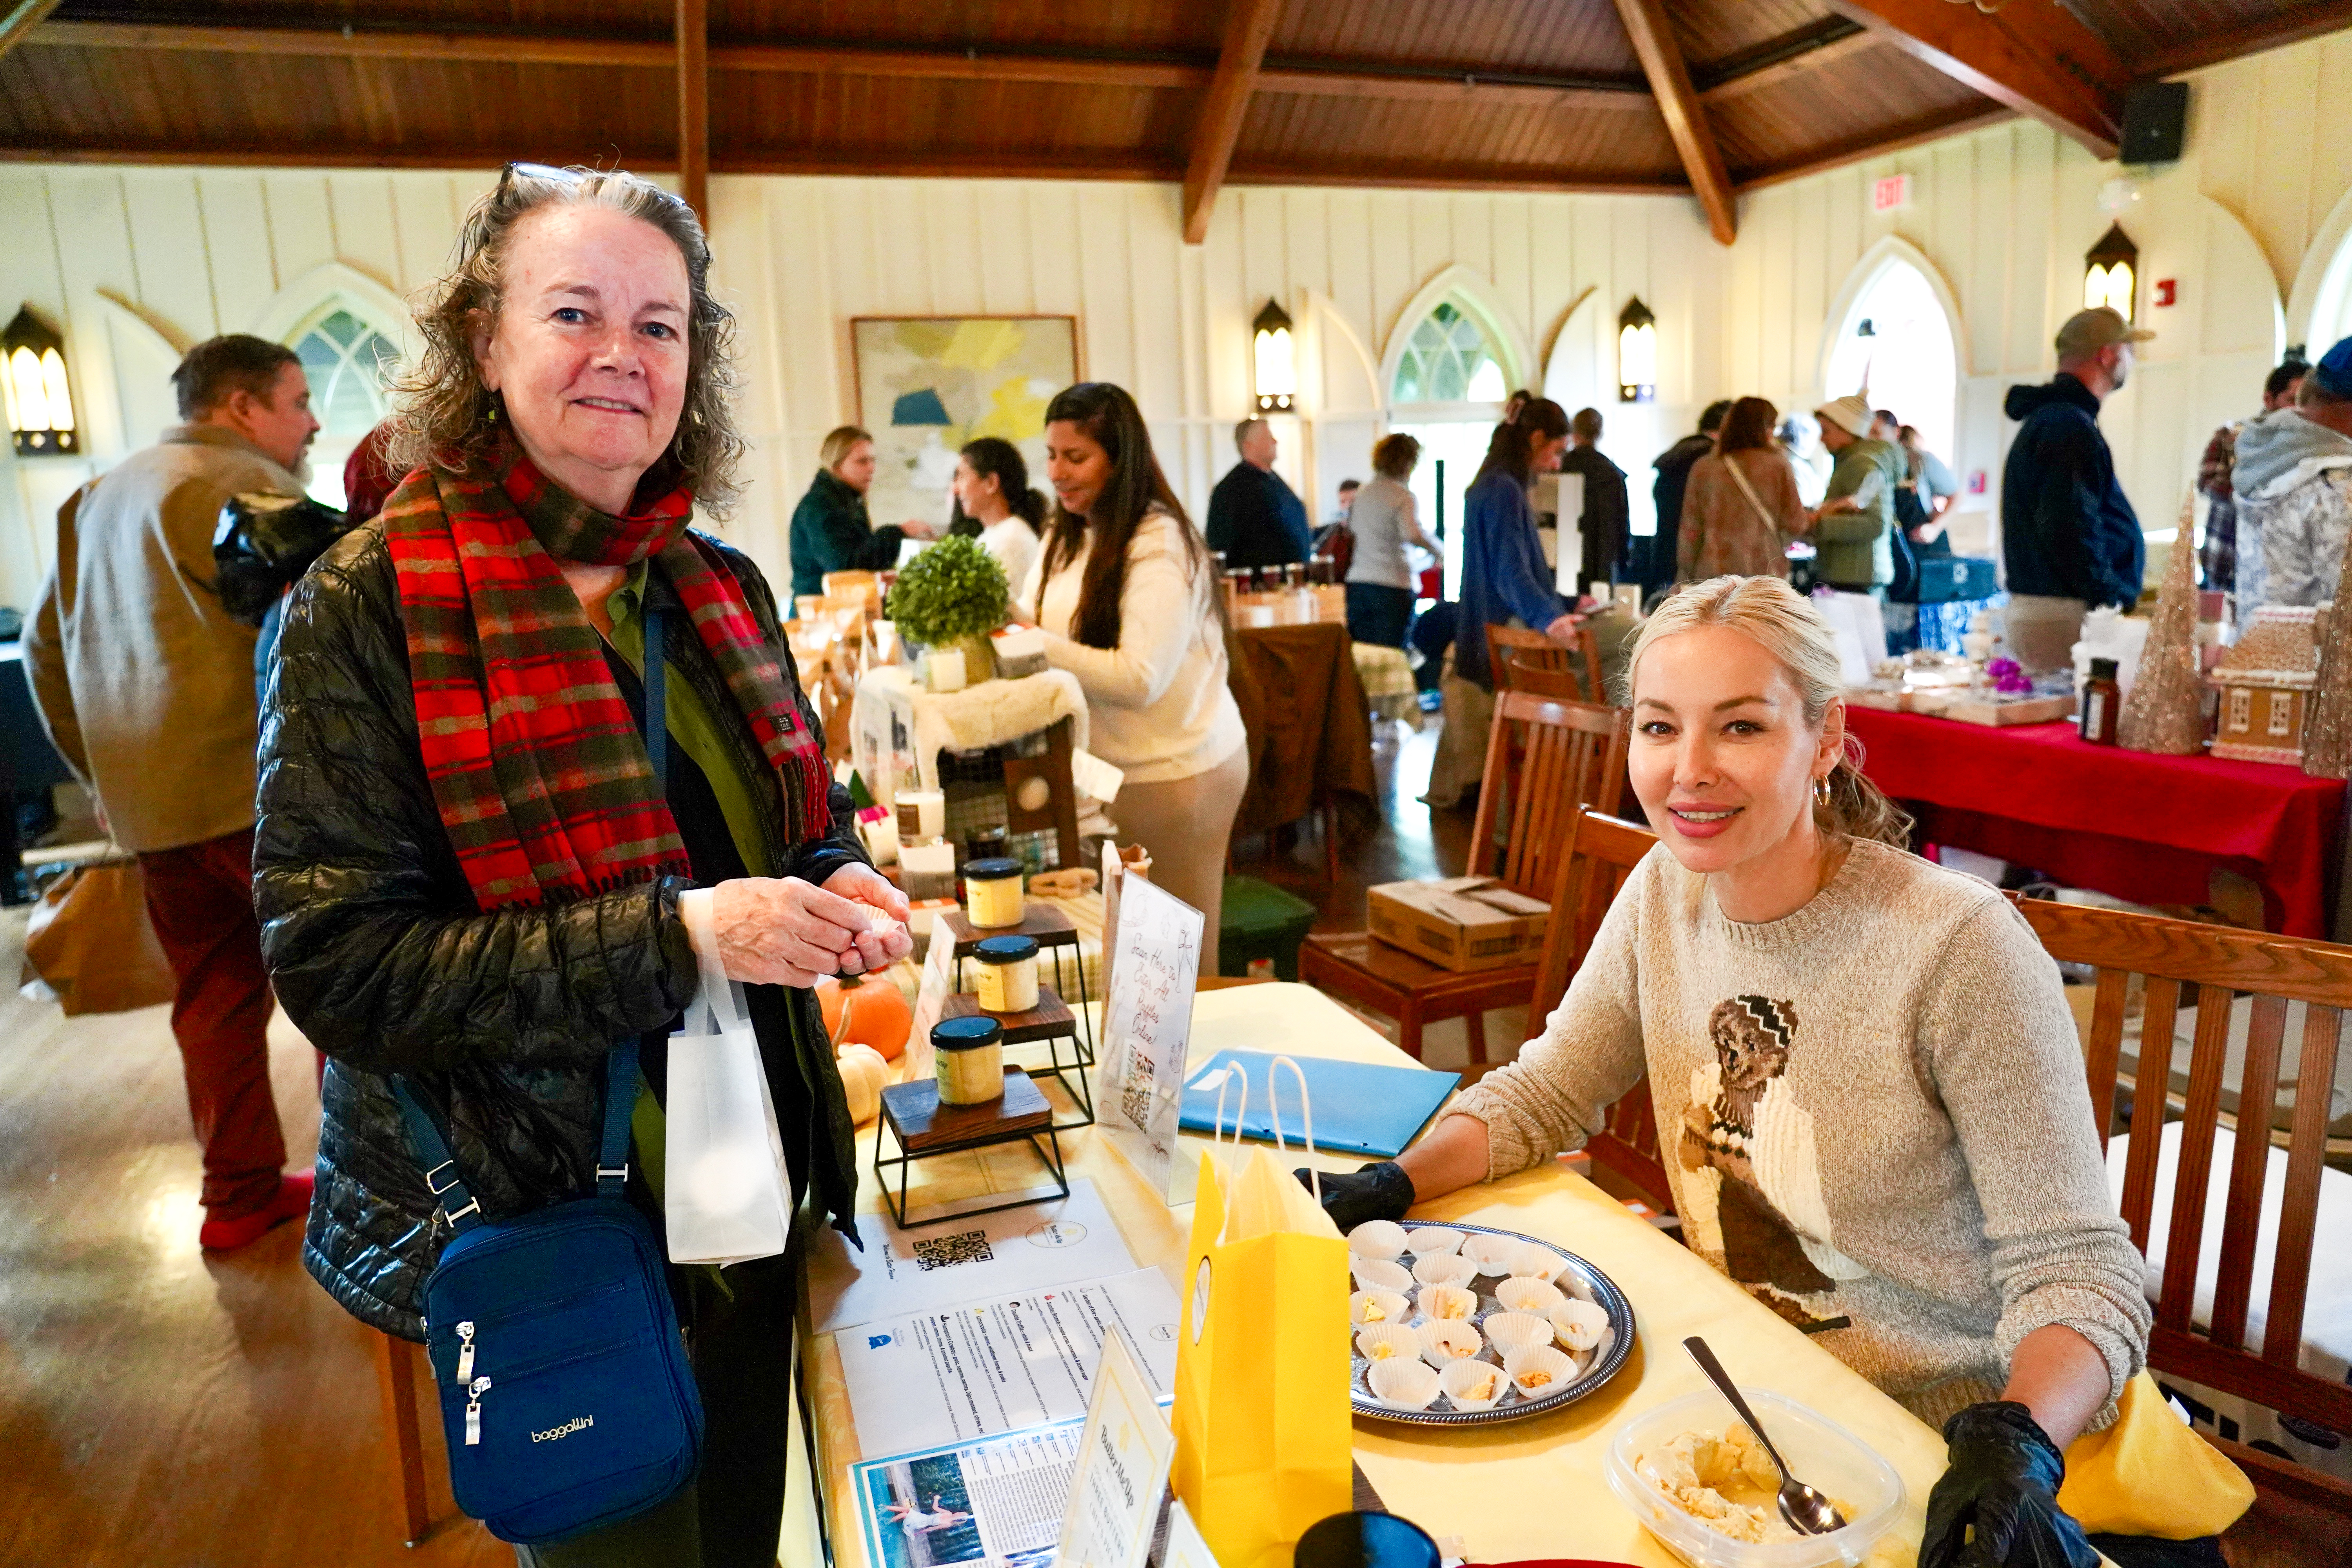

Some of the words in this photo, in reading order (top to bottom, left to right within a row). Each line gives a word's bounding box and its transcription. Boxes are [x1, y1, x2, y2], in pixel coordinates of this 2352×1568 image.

[1876, 176, 1904, 209] EXIT
[1150, 947, 1166, 974] Here
[1154, 980, 1170, 1002] All
[531, 1414, 594, 1443] baggallini
[1101, 1424, 1118, 1467] Butter
